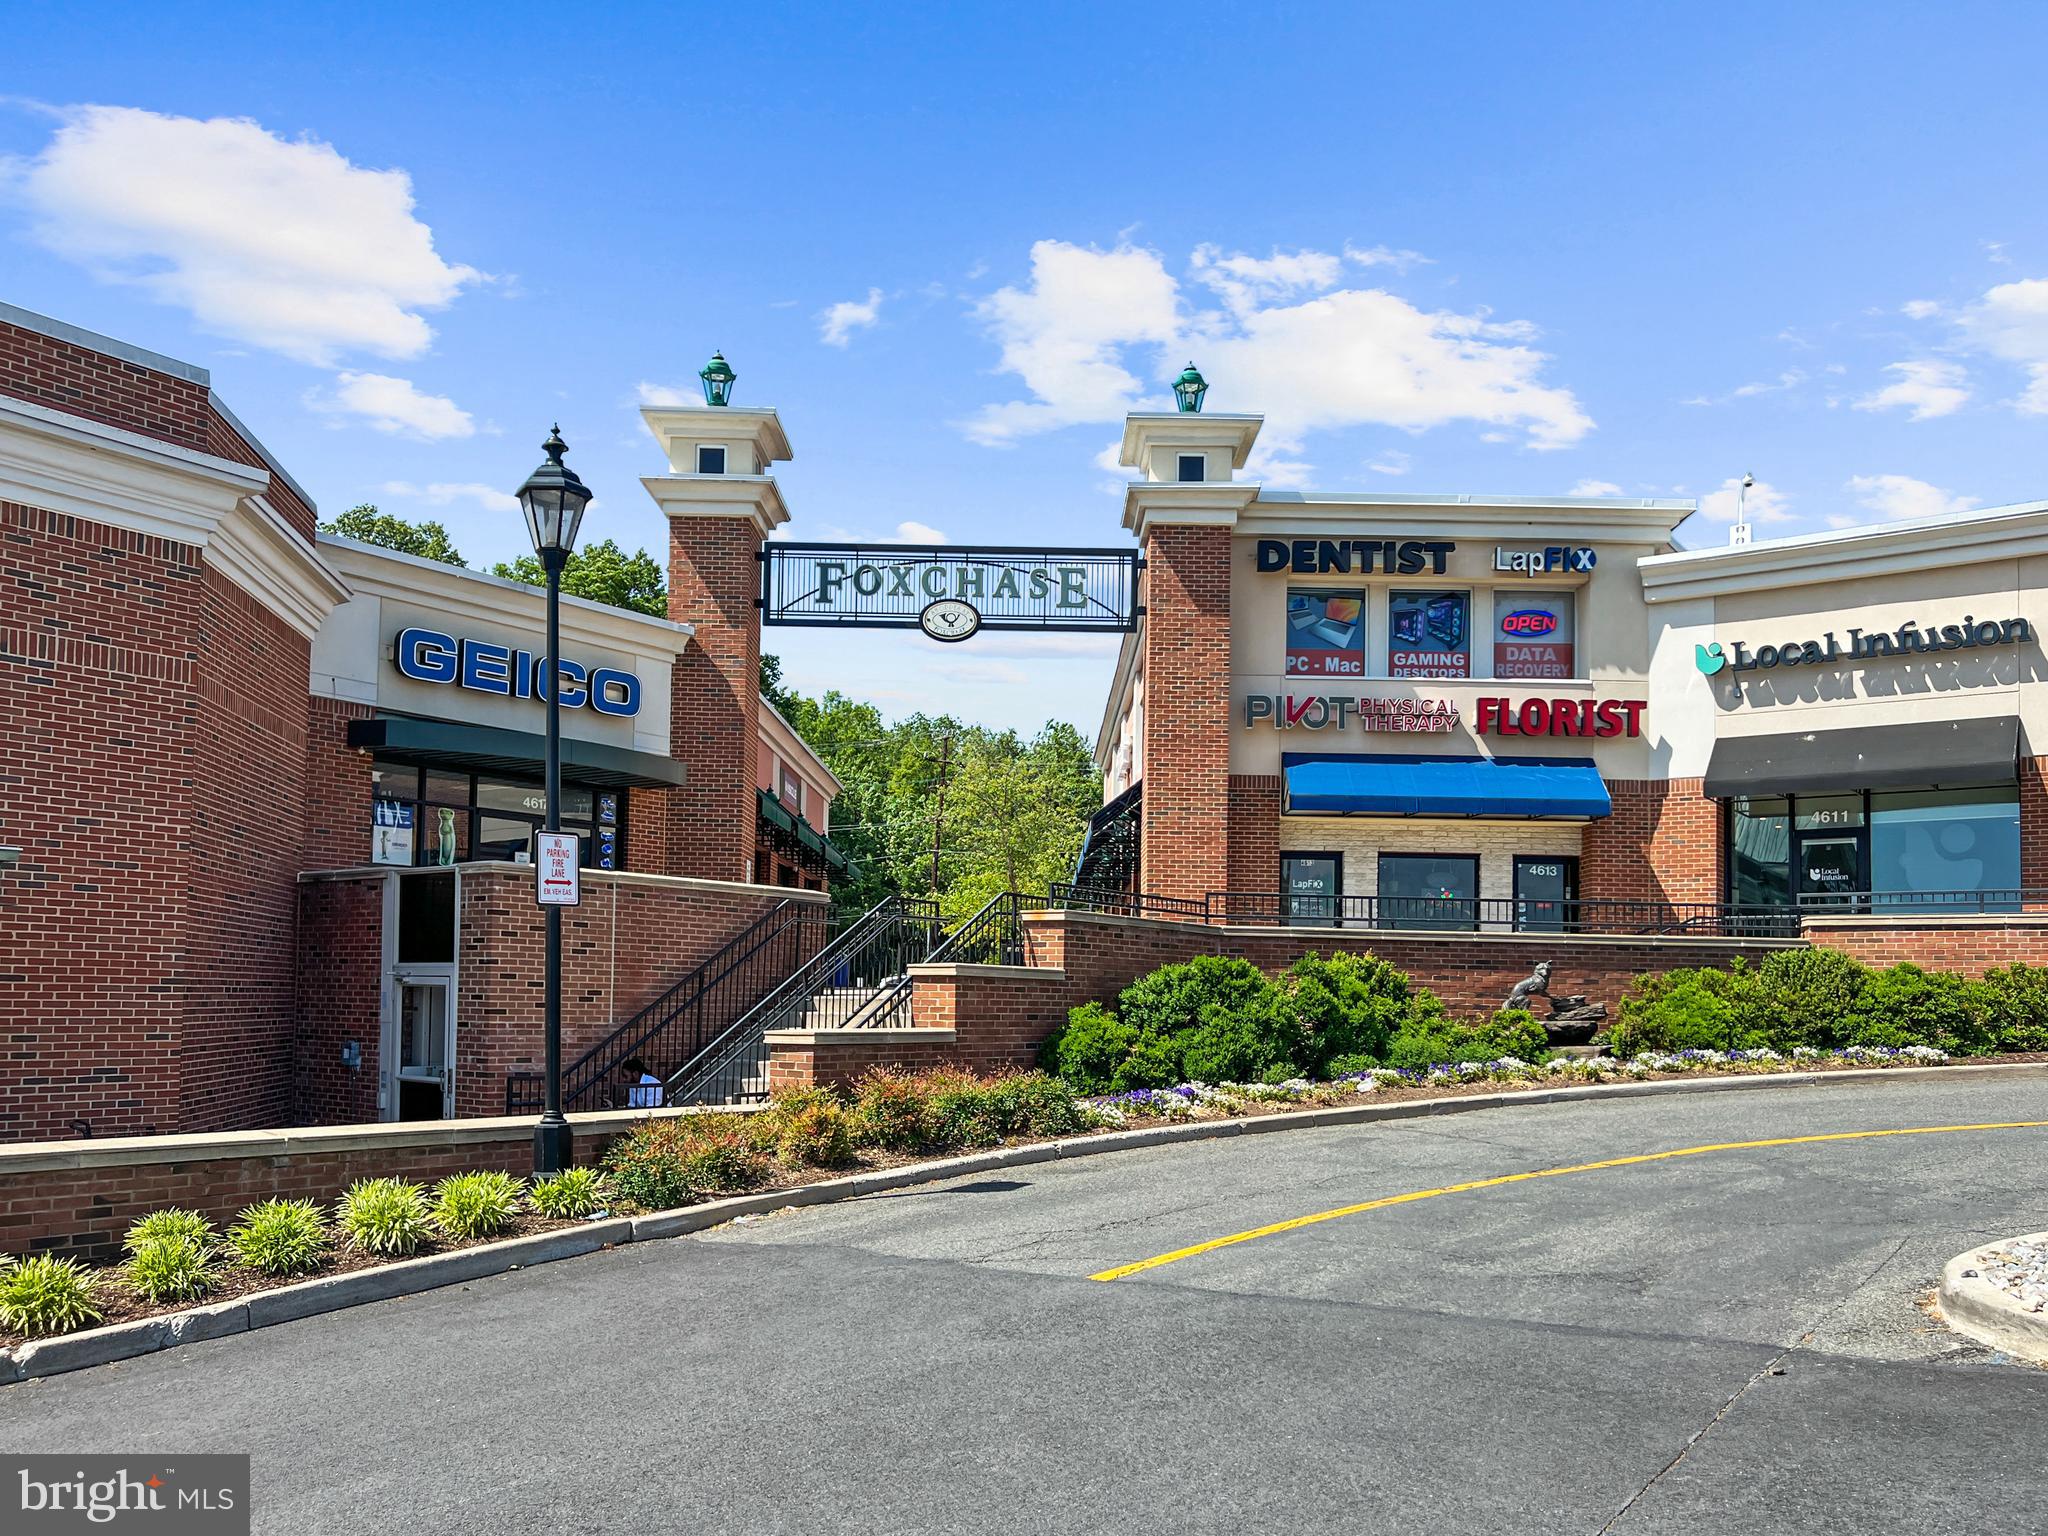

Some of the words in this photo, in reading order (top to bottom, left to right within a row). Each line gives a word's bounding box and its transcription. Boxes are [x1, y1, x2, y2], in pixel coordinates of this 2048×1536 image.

[1257, 540, 1455, 575] DENTIST
[814, 562, 1088, 609] FOXCHASE
[1502, 615, 1557, 633] OPEN
[1730, 631, 1838, 672] Local
[1847, 614, 2033, 661] Infusion
[1393, 652, 1466, 667] GAMING
[1505, 647, 1557, 662] DATA
[394, 627, 643, 718] GEICO
[1285, 656, 1308, 672] PC
[1325, 656, 1361, 674] Mac
[1393, 667, 1466, 679] DESKTOPS
[1496, 662, 1570, 678] RECOVERY
[1245, 694, 1355, 731] PIVOT
[1358, 697, 1460, 715] PHYSICAL
[1362, 713, 1461, 733] THERAPY
[1475, 696, 1649, 738] FLORIST
[1811, 810, 1848, 824] 4611
[553, 838, 563, 848] NO
[546, 848, 570, 859] PARKING
[552, 858, 564, 868] FIRE
[1529, 865, 1558, 876] 4613
[551, 868, 565, 878] LANE
[1821, 873, 1849, 881] Infusion
